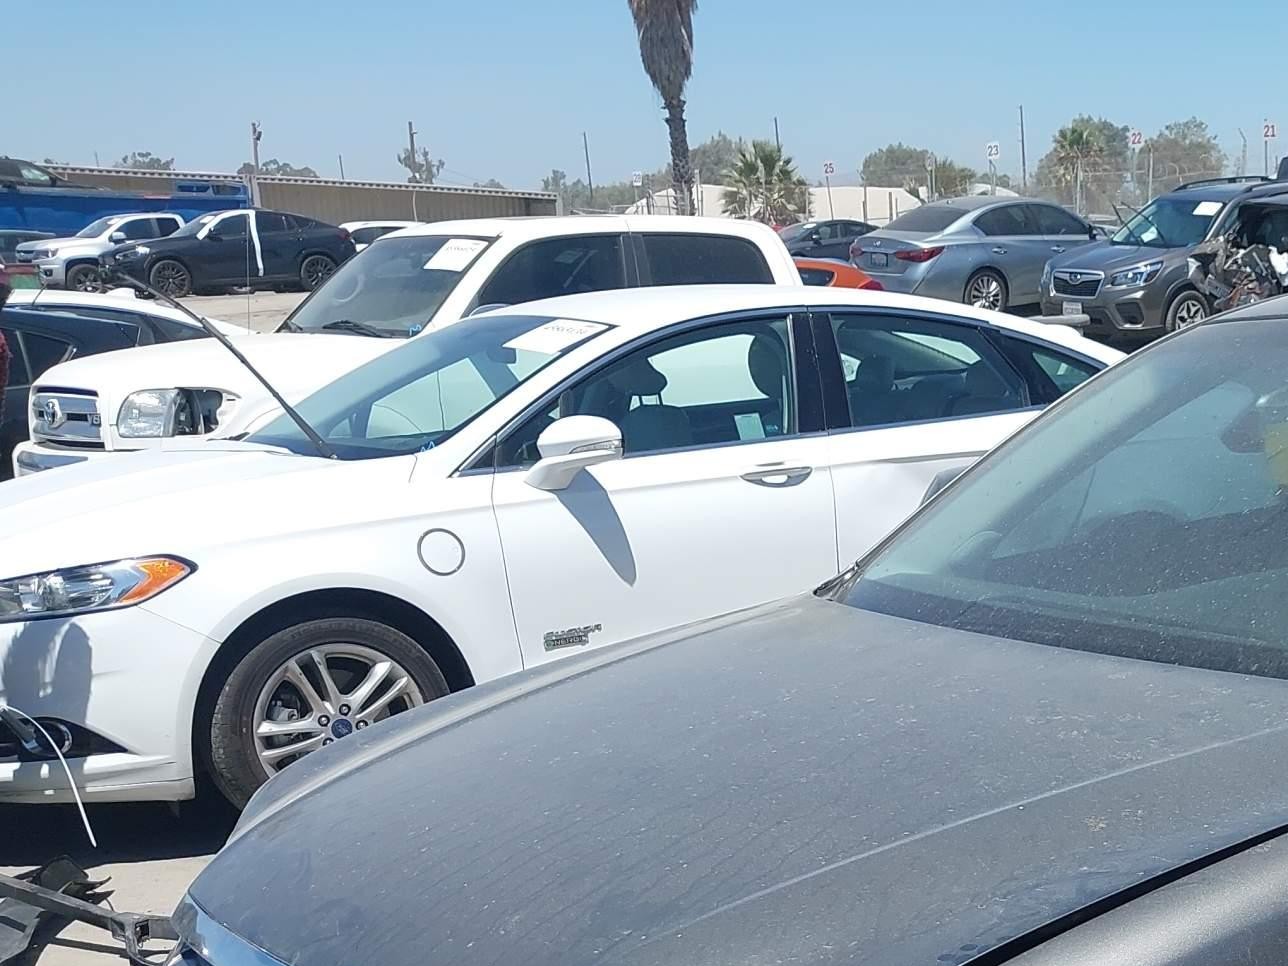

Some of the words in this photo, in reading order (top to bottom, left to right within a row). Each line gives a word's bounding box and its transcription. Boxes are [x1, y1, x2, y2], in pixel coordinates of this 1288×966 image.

[1263, 124, 1276, 138] 21
[1131, 132, 1142, 145] 22
[987, 144, 999, 157] 23
[823, 163, 834, 174] 25
[86, 413, 101, 425] V8
